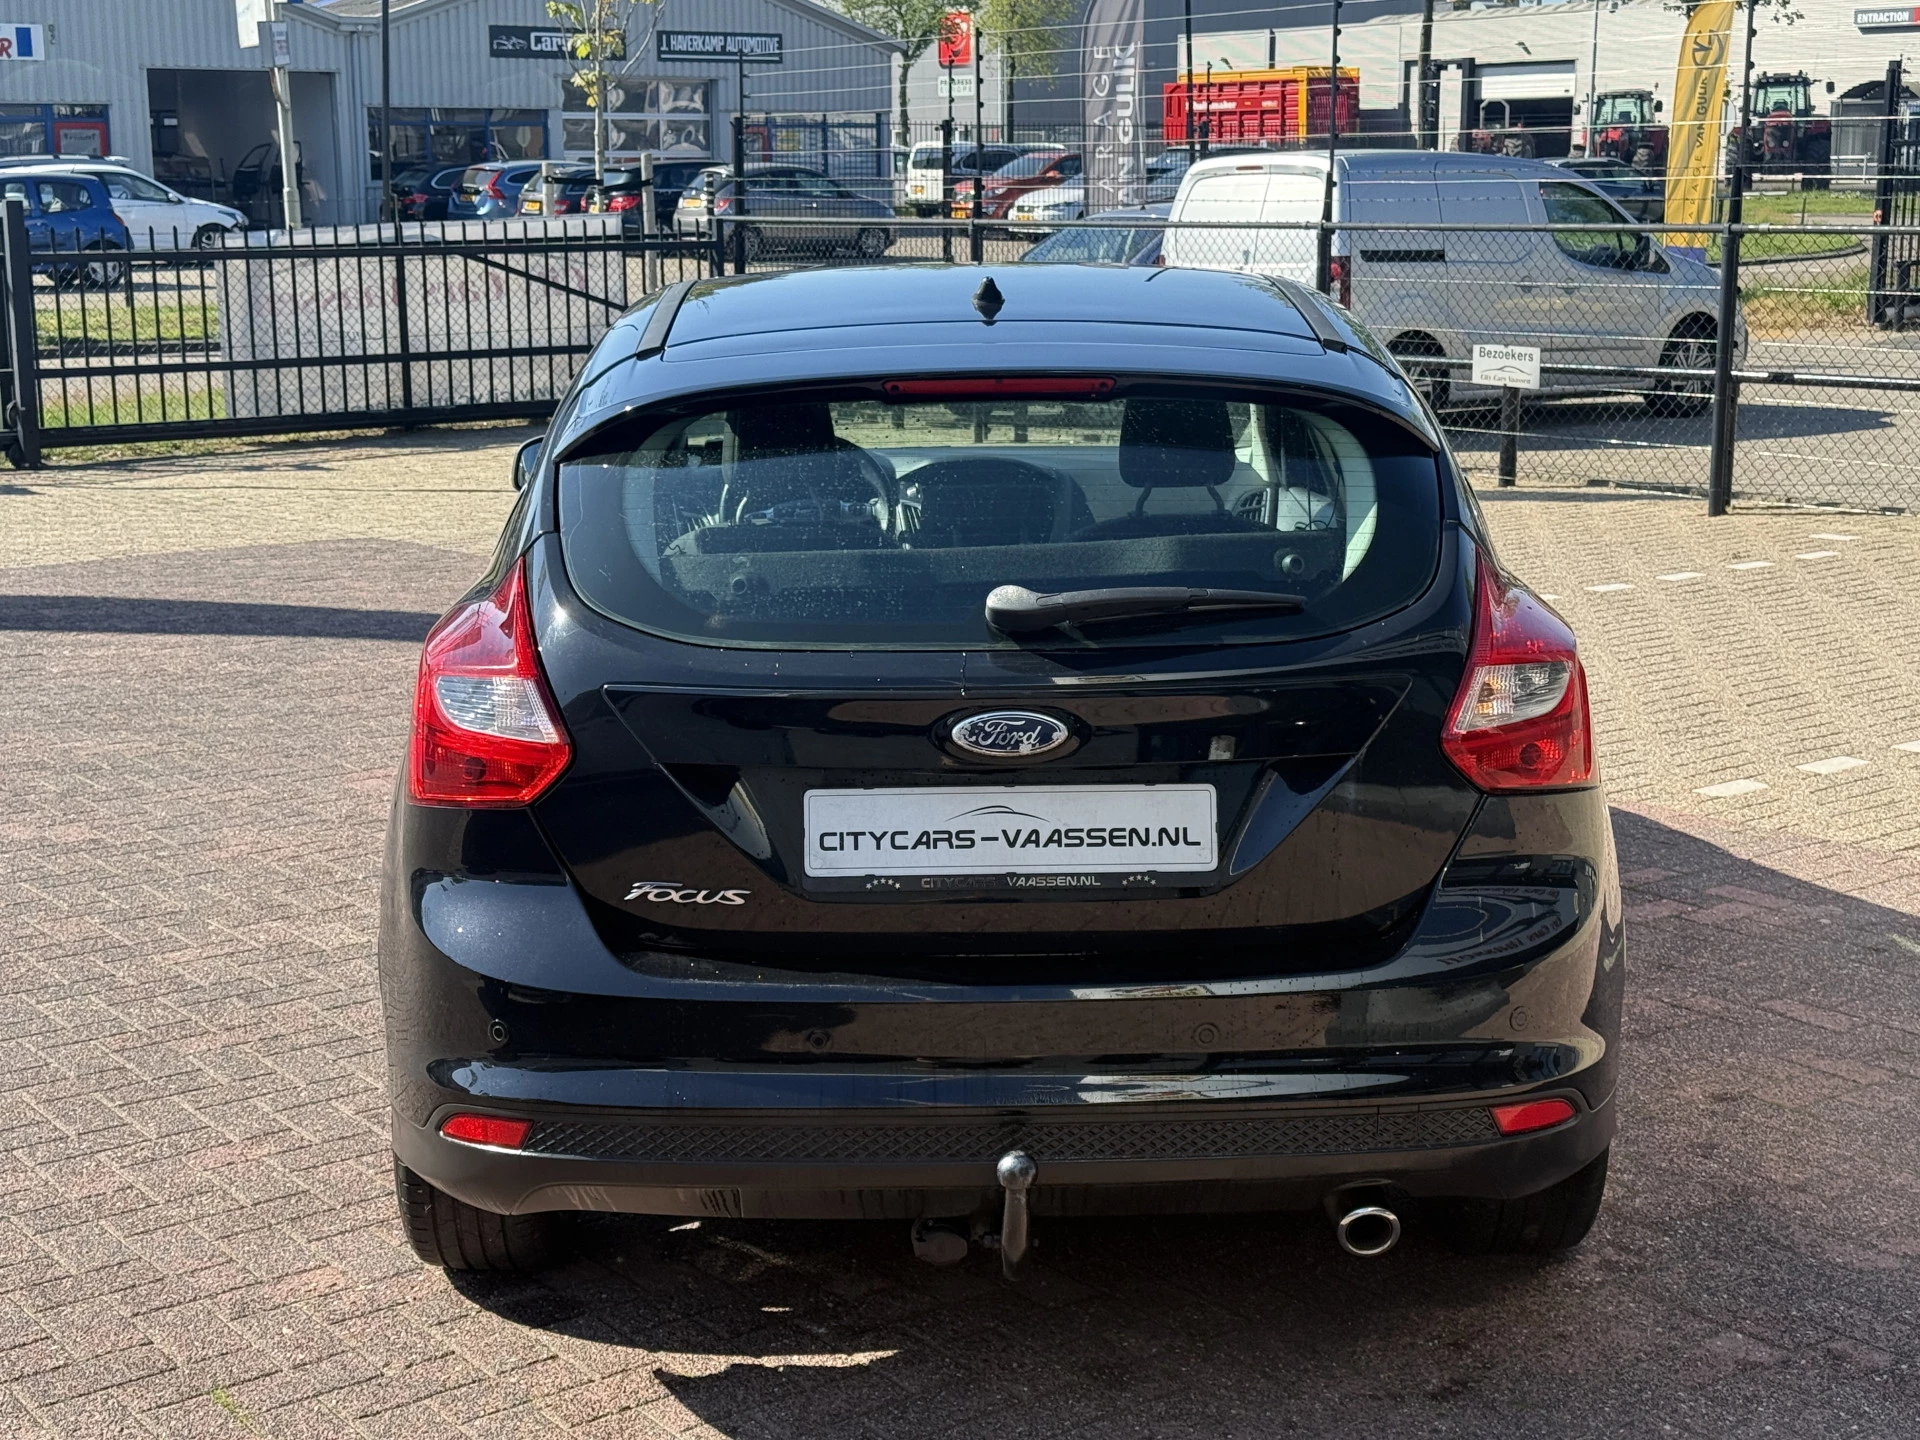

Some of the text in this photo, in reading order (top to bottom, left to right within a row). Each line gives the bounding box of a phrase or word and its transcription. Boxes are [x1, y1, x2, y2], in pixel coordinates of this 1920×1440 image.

[1857, 11, 1910, 24] ENTRACTION
[661, 34, 780, 54] J. HAVERKAMP AUTOMOTIVE
[1112, 42, 1136, 145] GULIK
[1479, 347, 1534, 362] Bezoekers
[978, 719, 1042, 746] Ford
[818, 825, 1202, 852] CITYCARS-VAASSEN.NL
[1006, 876, 1101, 888] VAASSEN.NL
